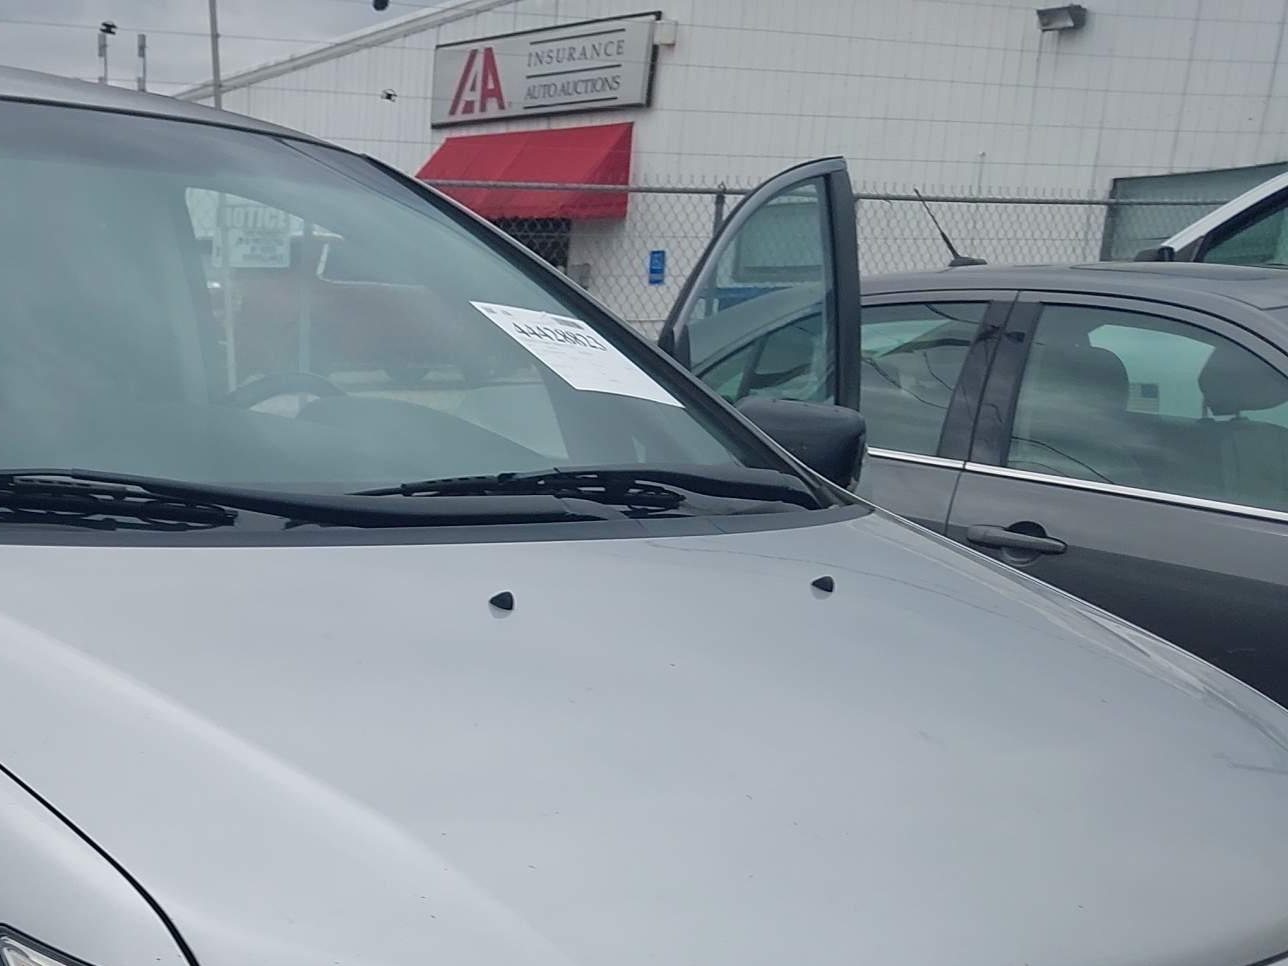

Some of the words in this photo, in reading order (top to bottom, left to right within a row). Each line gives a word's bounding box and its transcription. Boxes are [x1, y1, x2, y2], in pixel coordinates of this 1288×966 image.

[527, 39, 625, 68] INSURANCE
[525, 82, 558, 100] AUTO
[558, 74, 621, 97] AUCTIONS
